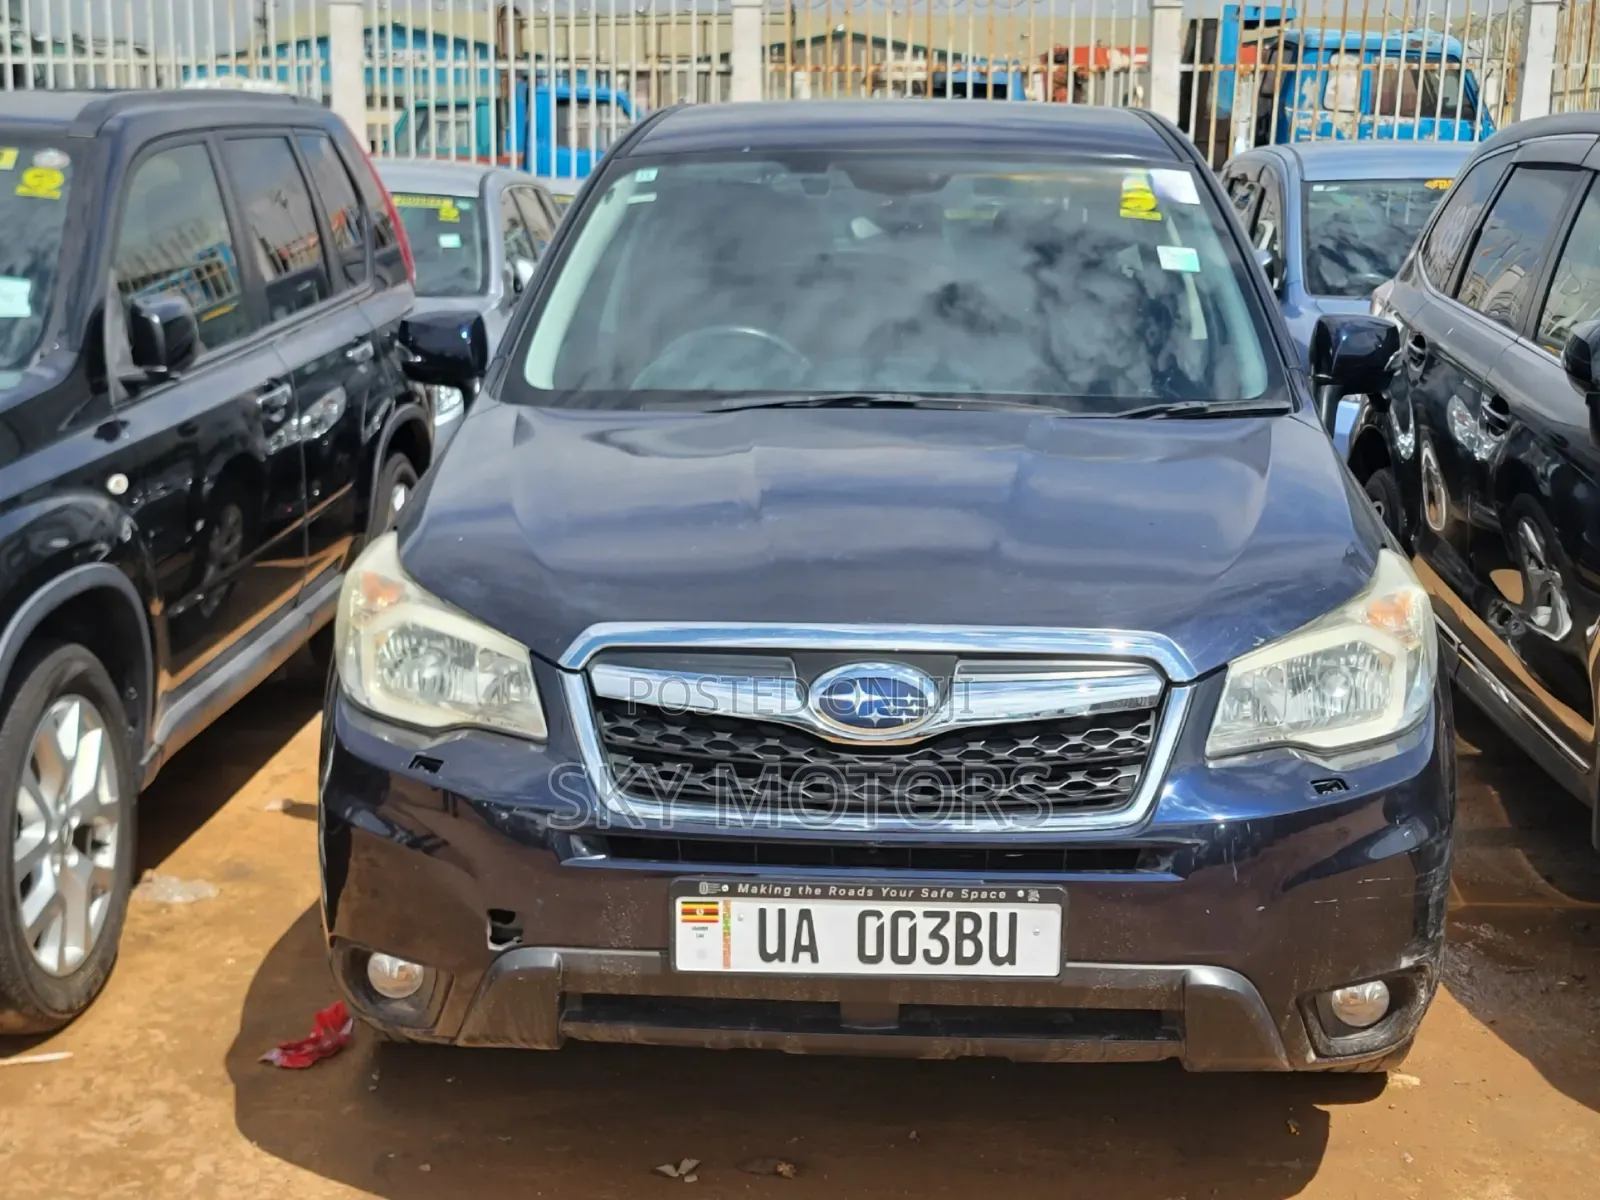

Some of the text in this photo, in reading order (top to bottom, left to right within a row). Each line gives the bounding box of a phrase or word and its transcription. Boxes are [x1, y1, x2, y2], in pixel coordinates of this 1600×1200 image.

[737, 883, 1007, 901] Making the Roads Your Safe Space
[758, 907, 1018, 966] UA 003BU
